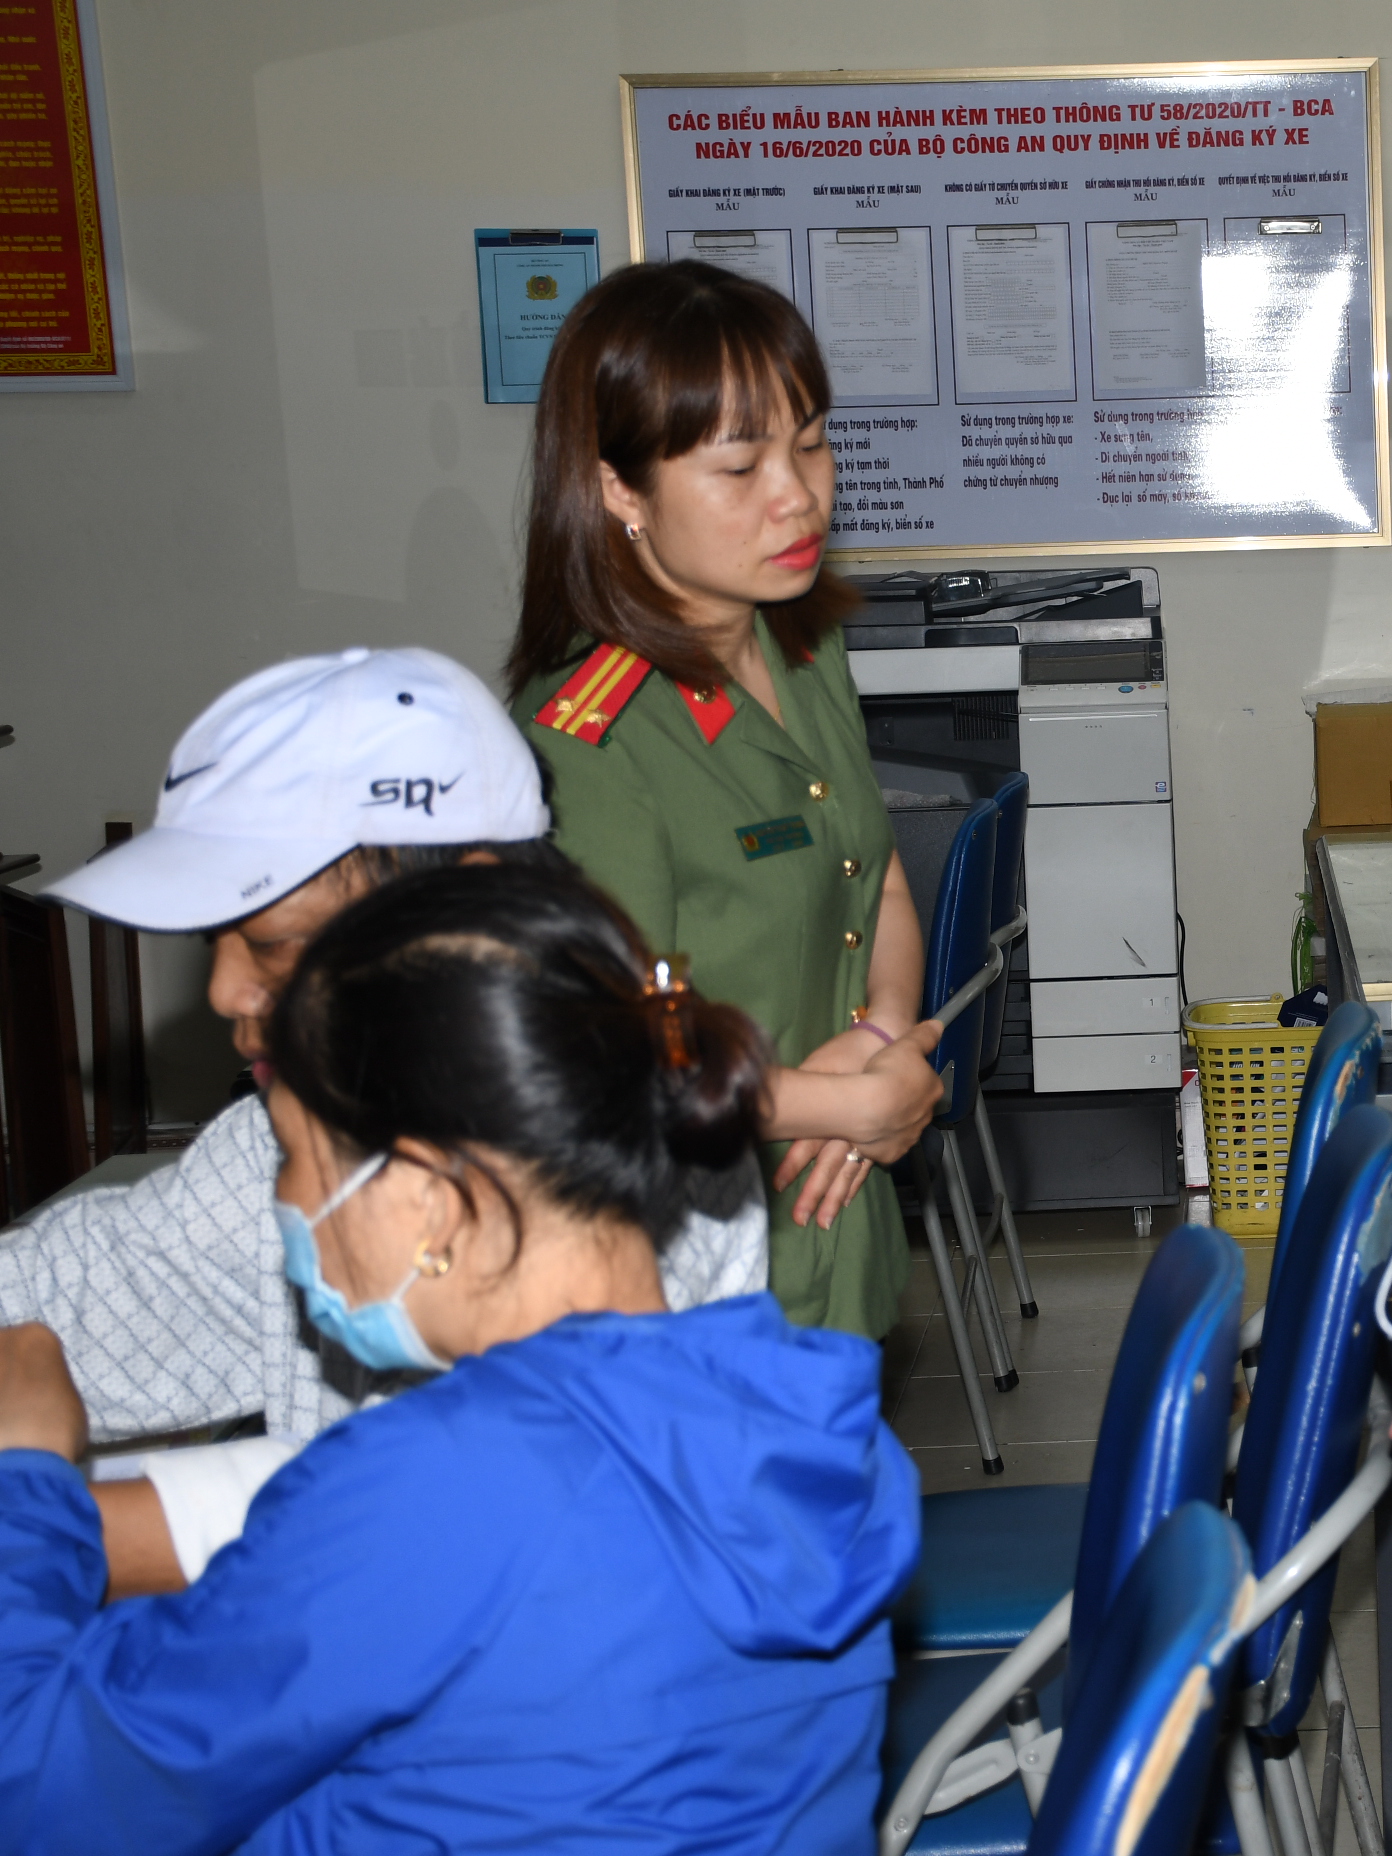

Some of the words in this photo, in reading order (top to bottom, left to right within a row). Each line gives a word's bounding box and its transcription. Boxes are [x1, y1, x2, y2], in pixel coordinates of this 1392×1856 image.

[668, 110, 710, 130] CÁC
[718, 106, 765, 129] BIỂU
[773, 105, 820, 128] MẪU
[827, 111, 870, 127] BAN
[878, 106, 934, 126] HÀNH
[942, 105, 987, 125] KÈM
[994, 106, 1046, 125] THEO
[1053, 102, 1121, 122] THÔNG
[1128, 102, 1155, 120] TƯ
[1160, 100, 1271, 119] 58/2020/TT
[1293, 98, 1334, 116] BCA
[696, 138, 752, 158] NGÀY
[760, 139, 862, 157] 16/6/2020
[870, 131, 911, 155] CỦA
[918, 134, 945, 157] BỘ
[953, 133, 1009, 154] CÔNG
[1017, 135, 1044, 152] AN
[1052, 134, 1091, 152] QUY
[1099, 132, 1149, 153] ĐỊNH
[1156, 125, 1180, 148] VỀ
[1187, 127, 1243, 147] ĐĂNG
[1252, 125, 1277, 145] KÝ
[1284, 127, 1309, 144] XE
[945, 182, 963, 192] KHÔNG
[965, 181, 972, 192] CÓ
[974, 180, 986, 191] GIẤY
[1061, 181, 1068, 190] XE
[1132, 179, 1141, 187] THU
[1199, 178, 1205, 186] XE
[1272, 175, 1281, 184] THU
[1341, 173, 1348, 181] XE
[669, 186, 683, 197] GIẤY
[686, 189, 700, 197] KHAI
[703, 187, 721, 197] ĐĂNG
[723, 187, 731, 197] KÝ
[733, 188, 741, 197] XE
[744, 188, 759, 199] (MẶT
[762, 185, 785, 197] TRƯỚC)
[814, 184, 827, 196] GIẤY
[830, 187, 845, 195] KHAI
[847, 185, 865, 195] ĐĂNG
[867, 184, 875, 195] KÝ
[877, 186, 885, 194] XE
[906, 184, 921, 194] SAU)
[1134, 189, 1157, 202] MẪU
[1272, 185, 1295, 197] MẪU
[716, 199, 740, 211] MẪU
[856, 196, 879, 208] MẪU
[996, 193, 1019, 205] MẪU
[828, 419, 847, 433] dụng
[850, 419, 870, 431] trong
[873, 416, 899, 431] trường
[901, 417, 918, 432] hợp:
[961, 413, 971, 427] Sử
[973, 414, 992, 430] dụng
[995, 415, 1015, 428] trong
[1018, 411, 1043, 427] trường
[1046, 412, 1060, 427] hợp
[1063, 414, 1073, 424] xe:
[1094, 409, 1105, 423] Sử
[1108, 410, 1128, 426] dụng
[1131, 410, 1154, 424] trong
[845, 438, 854, 452] ký
[856, 438, 871, 450] mới
[962, 435, 973, 447] Đã
[975, 430, 1002, 450] chuyển
[1005, 431, 1028, 449] quyền
[1031, 433, 1039, 446] sở
[1042, 433, 1056, 445] hữu
[1059, 435, 1072, 448] qua
[1100, 431, 1111, 443] Xe
[1137, 430, 1153, 443] tên,
[963, 454, 984, 468] nhiều
[986, 455, 1008, 470] người
[1010, 455, 1034, 468] không
[1037, 453, 1045, 466] có
[1101, 451, 1110, 463] Di
[1113, 446, 1142, 465] chuyển
[1146, 450, 1169, 464] ngoài
[845, 458, 854, 472] ký
[857, 459, 872, 475] tạm
[874, 458, 889, 470] thời
[846, 477, 858, 490] tên
[860, 478, 881, 492] trong
[883, 476, 901, 490] tỉnh,
[903, 476, 927, 489] Thành
[930, 474, 944, 489] Phố
[964, 476, 987, 489] chứng
[990, 475, 997, 487] từ
[1000, 470, 1027, 488] chuyển
[1030, 474, 1058, 490] nhượng
[1102, 469, 1116, 483] Hết
[1119, 471, 1136, 483] niên
[1139, 471, 1154, 486] hạn
[1157, 468, 1167, 482] sử
[840, 498, 854, 515] tạo,
[857, 496, 869, 510] đổi
[872, 497, 888, 510] màu
[891, 499, 904, 510] sơn
[1102, 492, 1119, 507] Đục
[1122, 491, 1132, 507] lại
[1138, 488, 1147, 502] số
[829, 517, 841, 535] ấp
[843, 516, 858, 531] mất
[860, 518, 879, 533] đăng
[882, 516, 893, 532] ký,
[896, 513, 911, 530] biển
[914, 516, 923, 530] số
[925, 518, 934, 530] xe
[240, 873, 274, 900] NIKE
[1150, 998, 1154, 1006] 1
[1150, 1055, 1156, 1064] 2
